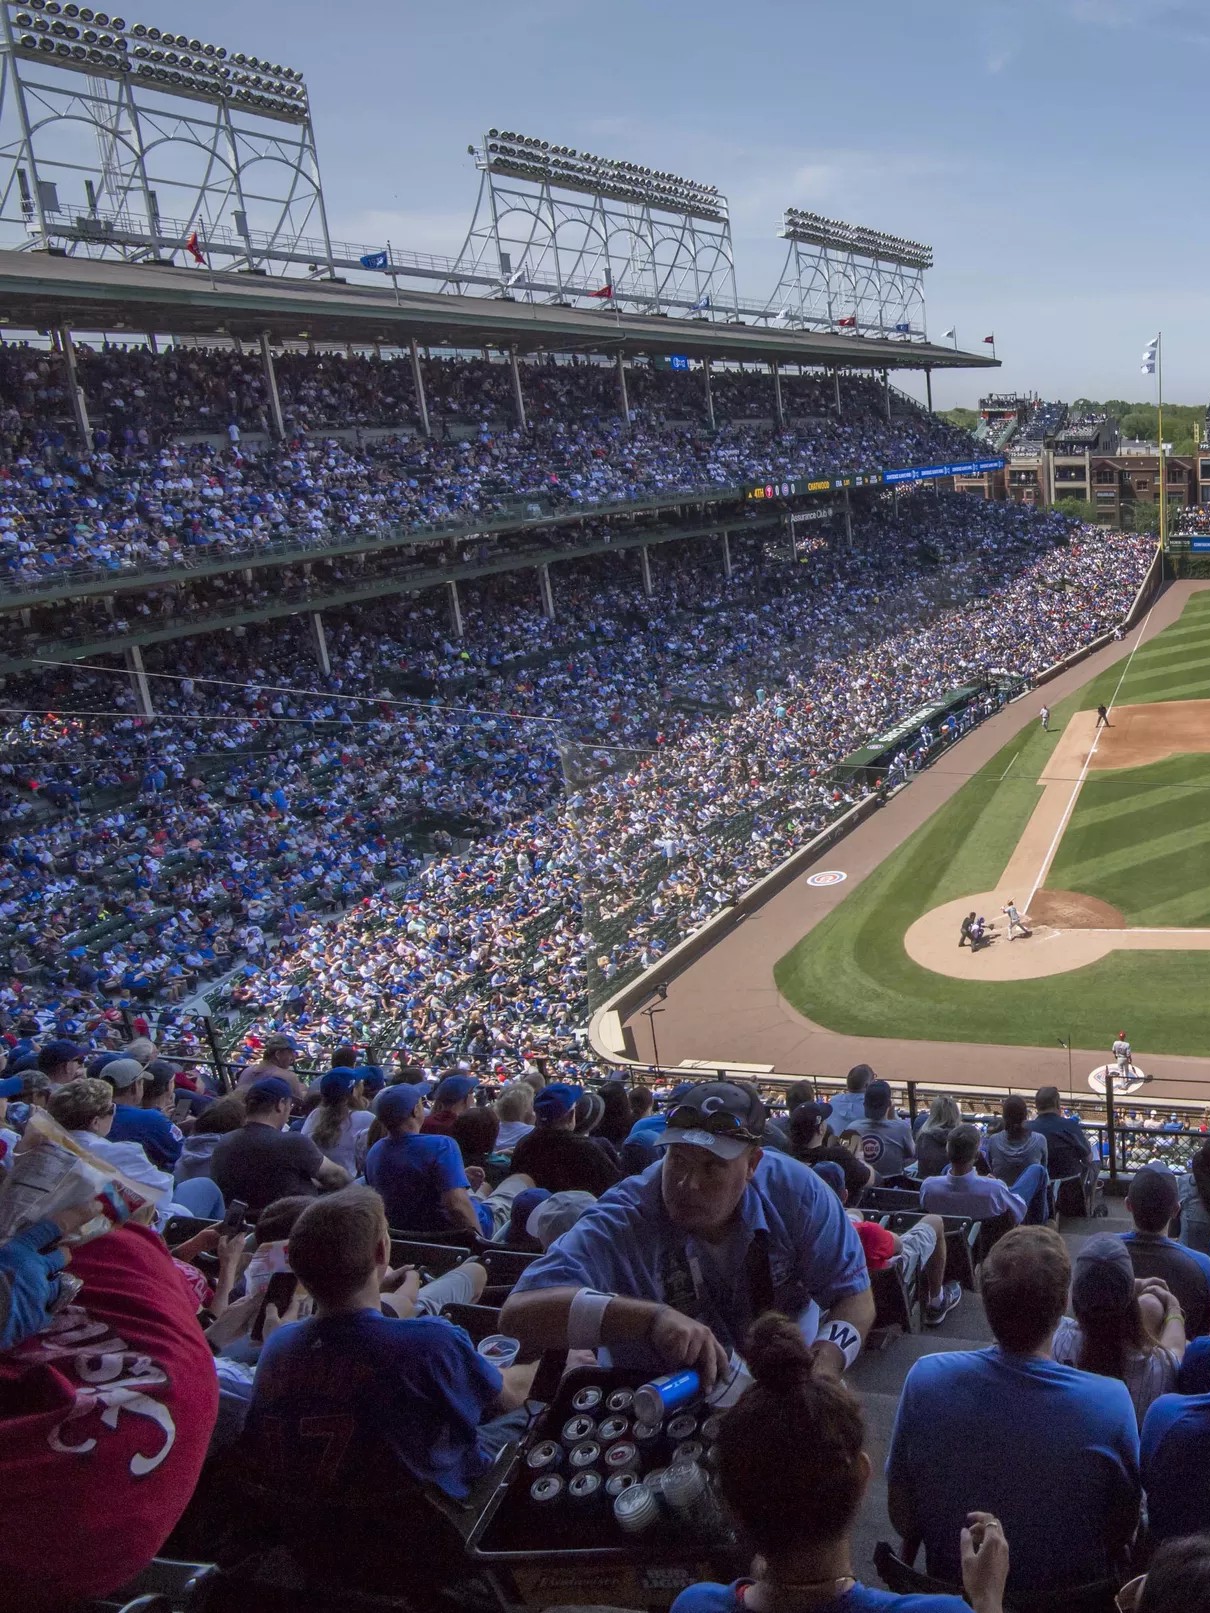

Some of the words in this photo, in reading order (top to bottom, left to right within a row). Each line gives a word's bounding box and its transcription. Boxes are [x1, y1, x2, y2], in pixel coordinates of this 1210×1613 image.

[808, 480, 830, 491] CHATWOOD
[791, 511, 816, 522] Assurance
[816, 509, 827, 518] Club
[828, 1324, 858, 1350] W
